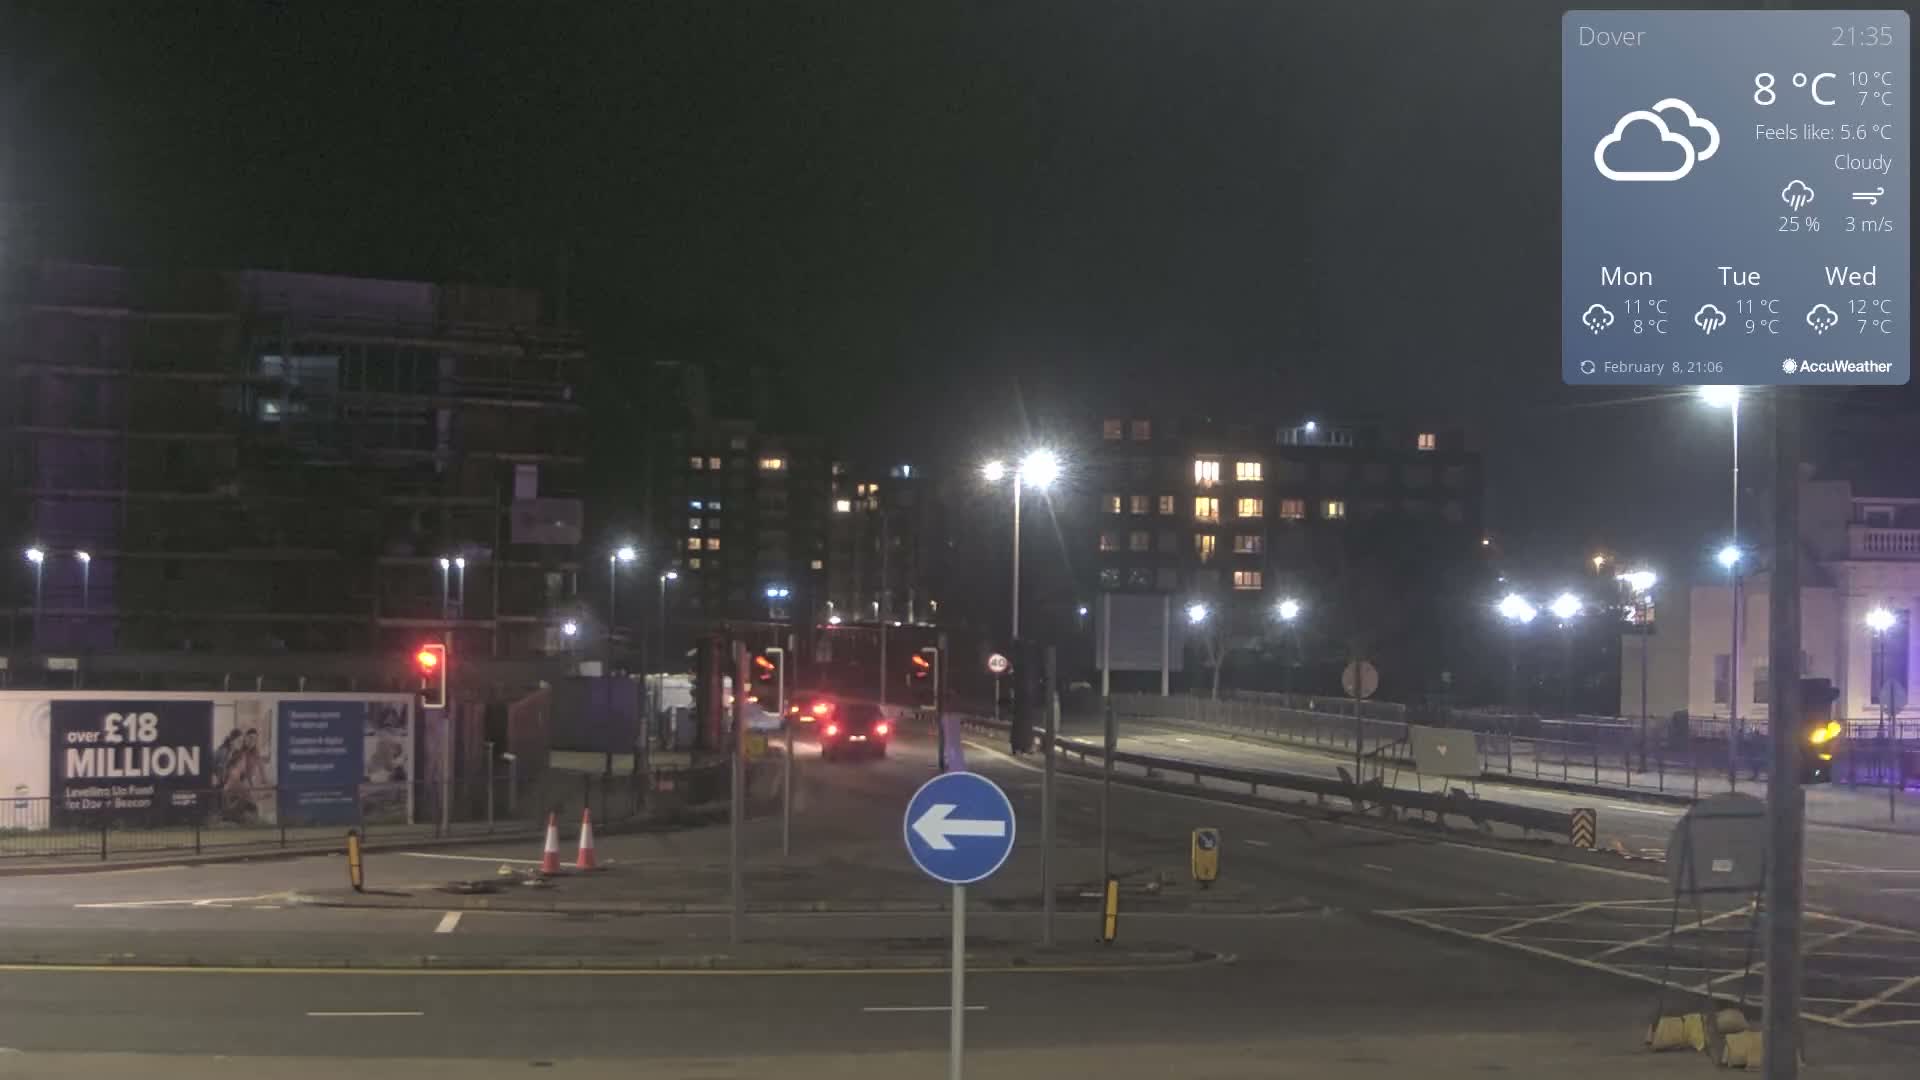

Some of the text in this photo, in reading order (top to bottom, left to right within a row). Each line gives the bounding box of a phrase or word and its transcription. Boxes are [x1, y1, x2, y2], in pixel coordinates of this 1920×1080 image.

[991, 658, 1007, 667] 40
[67, 712, 158, 744] over £18
[66, 746, 200, 778] MILLION
